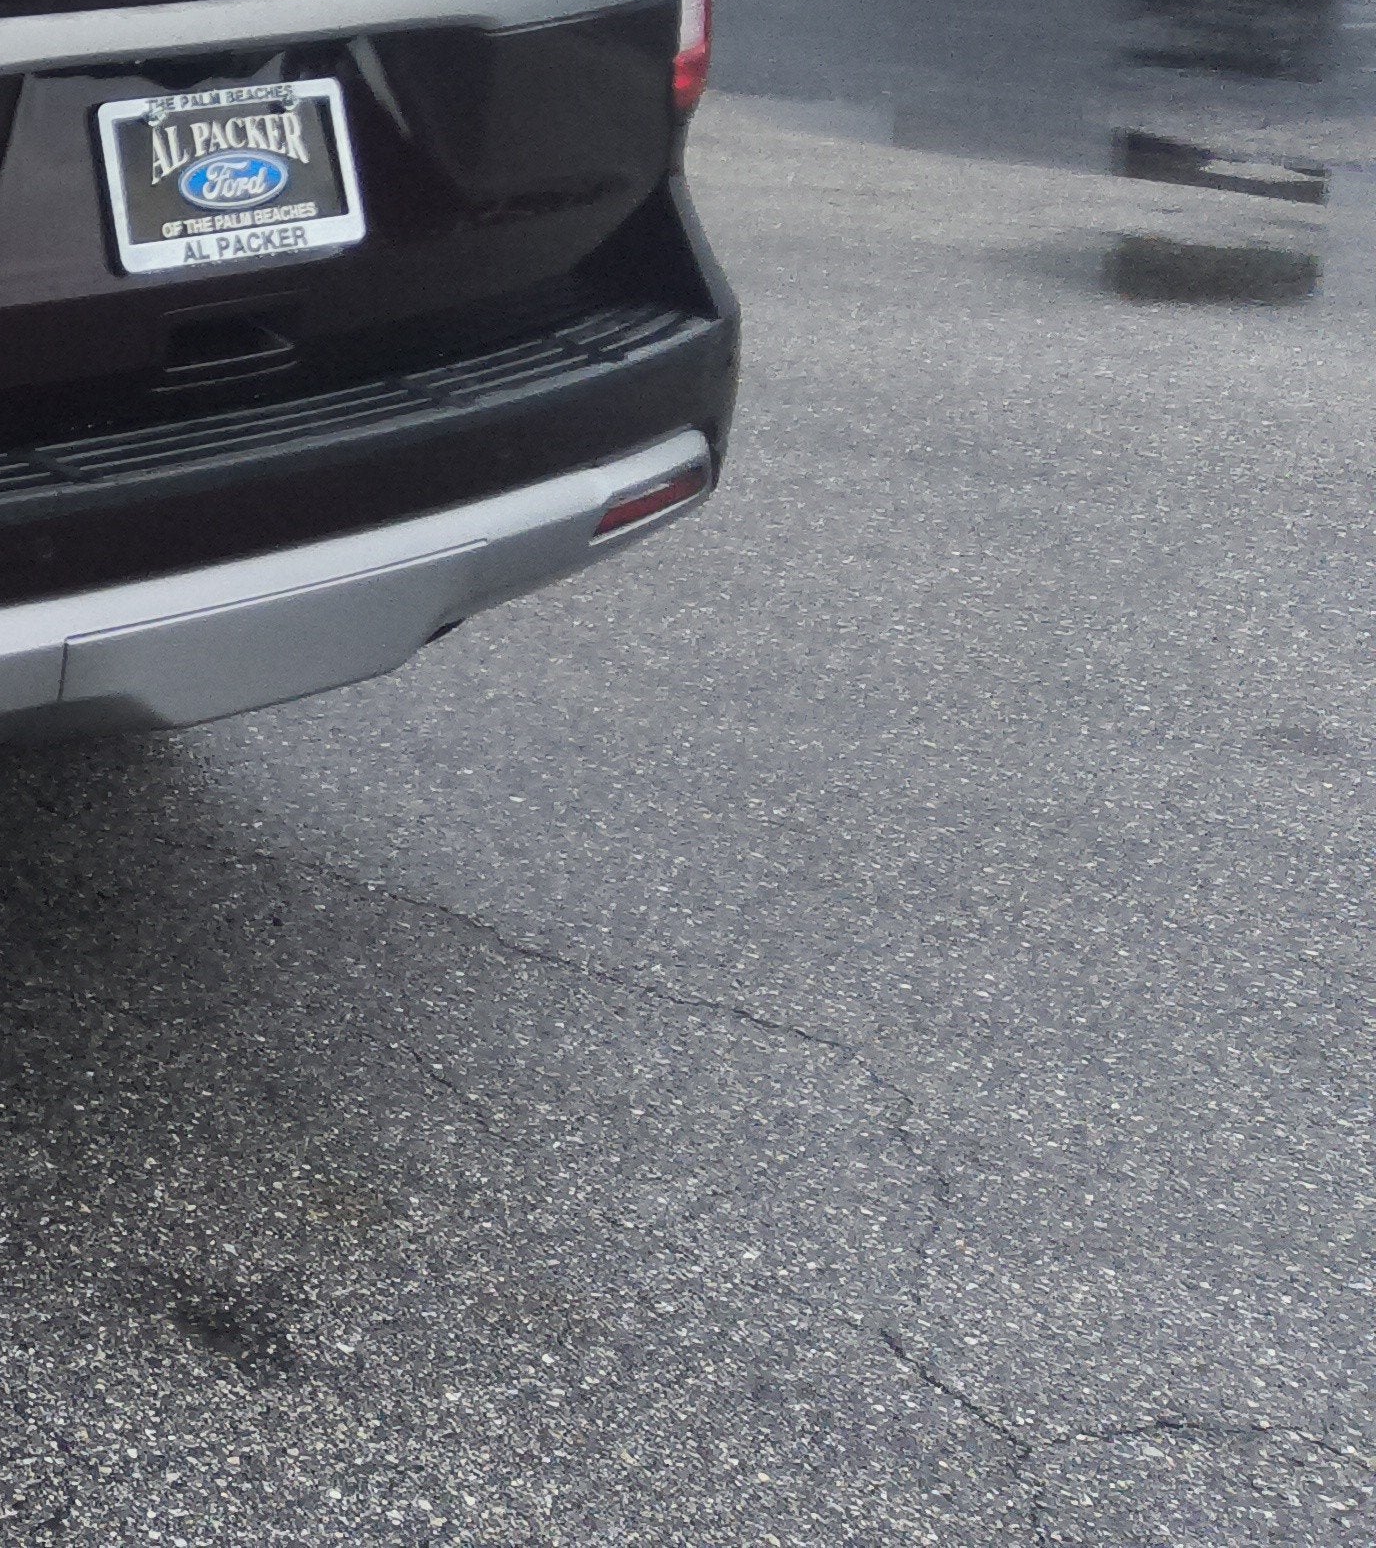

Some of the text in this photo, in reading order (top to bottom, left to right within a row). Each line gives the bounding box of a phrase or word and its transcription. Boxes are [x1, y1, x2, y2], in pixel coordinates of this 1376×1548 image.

[180, 91, 221, 109] PALM
[151, 112, 309, 185] AL PACKER
[202, 161, 268, 200] Ford
[162, 202, 318, 239] OF THE PALM BEACHES
[183, 225, 309, 263] AL PACKER
